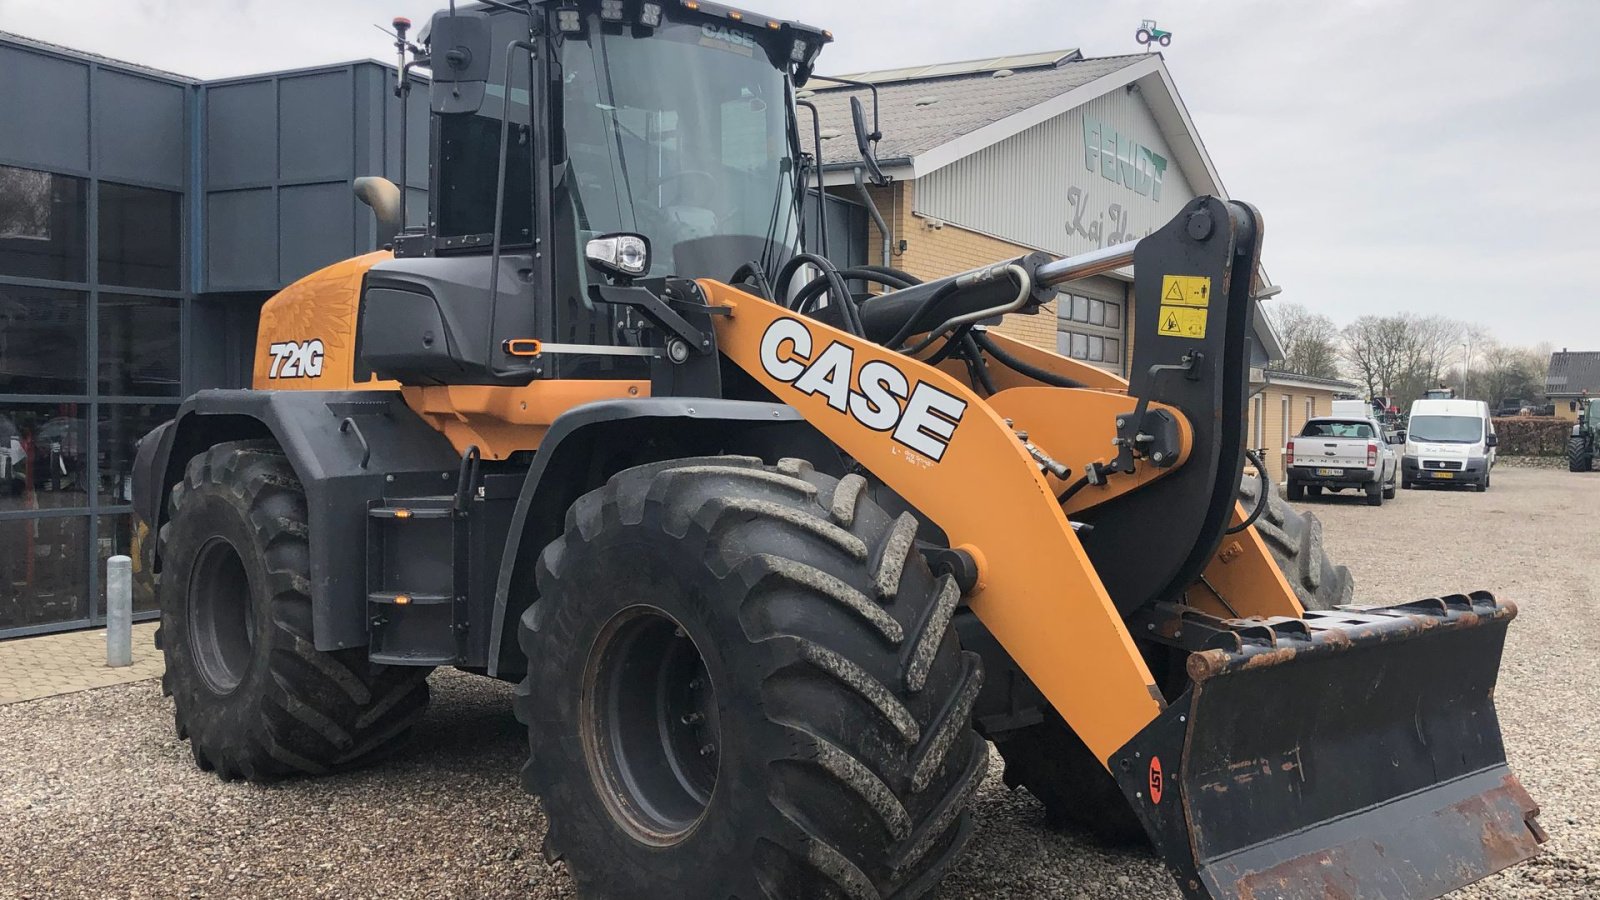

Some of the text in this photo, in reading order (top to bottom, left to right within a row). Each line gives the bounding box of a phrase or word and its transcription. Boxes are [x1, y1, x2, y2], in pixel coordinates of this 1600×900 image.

[702, 22, 754, 48] CASE
[1083, 113, 1167, 202] FENDT
[1065, 185, 1104, 248] Kaj
[269, 338, 324, 379] 721G
[760, 317, 968, 463] CASE
